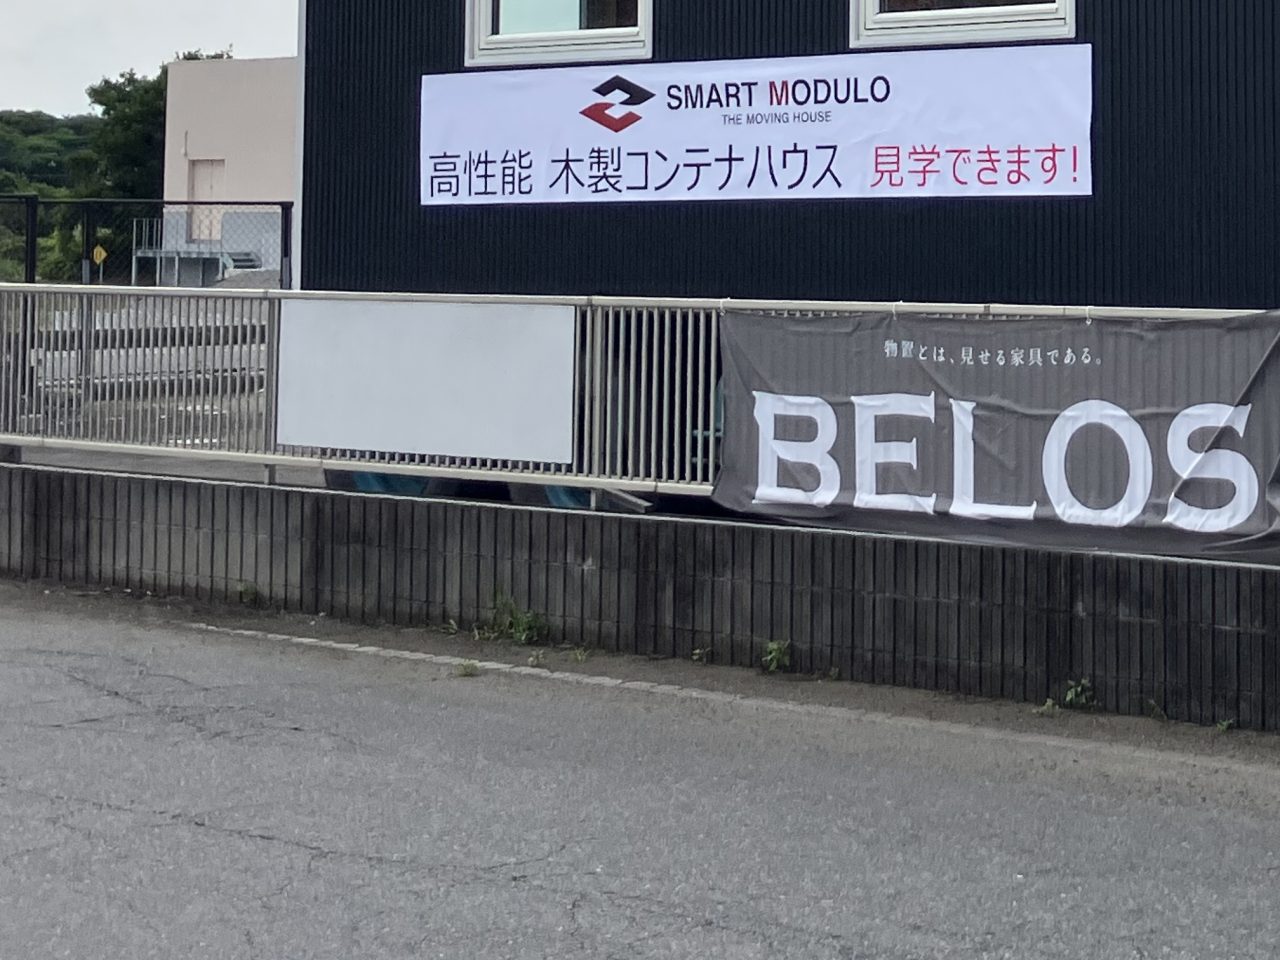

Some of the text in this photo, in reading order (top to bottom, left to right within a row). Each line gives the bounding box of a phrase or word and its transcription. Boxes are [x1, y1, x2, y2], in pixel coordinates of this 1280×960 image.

[666, 75, 891, 111] SMART MODULO
[721, 110, 832, 126] THE MOVING HOUSE
[428, 149, 534, 197] 高性能
[548, 142, 842, 196] 木製コンテナハウス
[884, 339, 1102, 367] 物置とは、見せる家具である。
[752, 390, 1260, 532] BELOS
